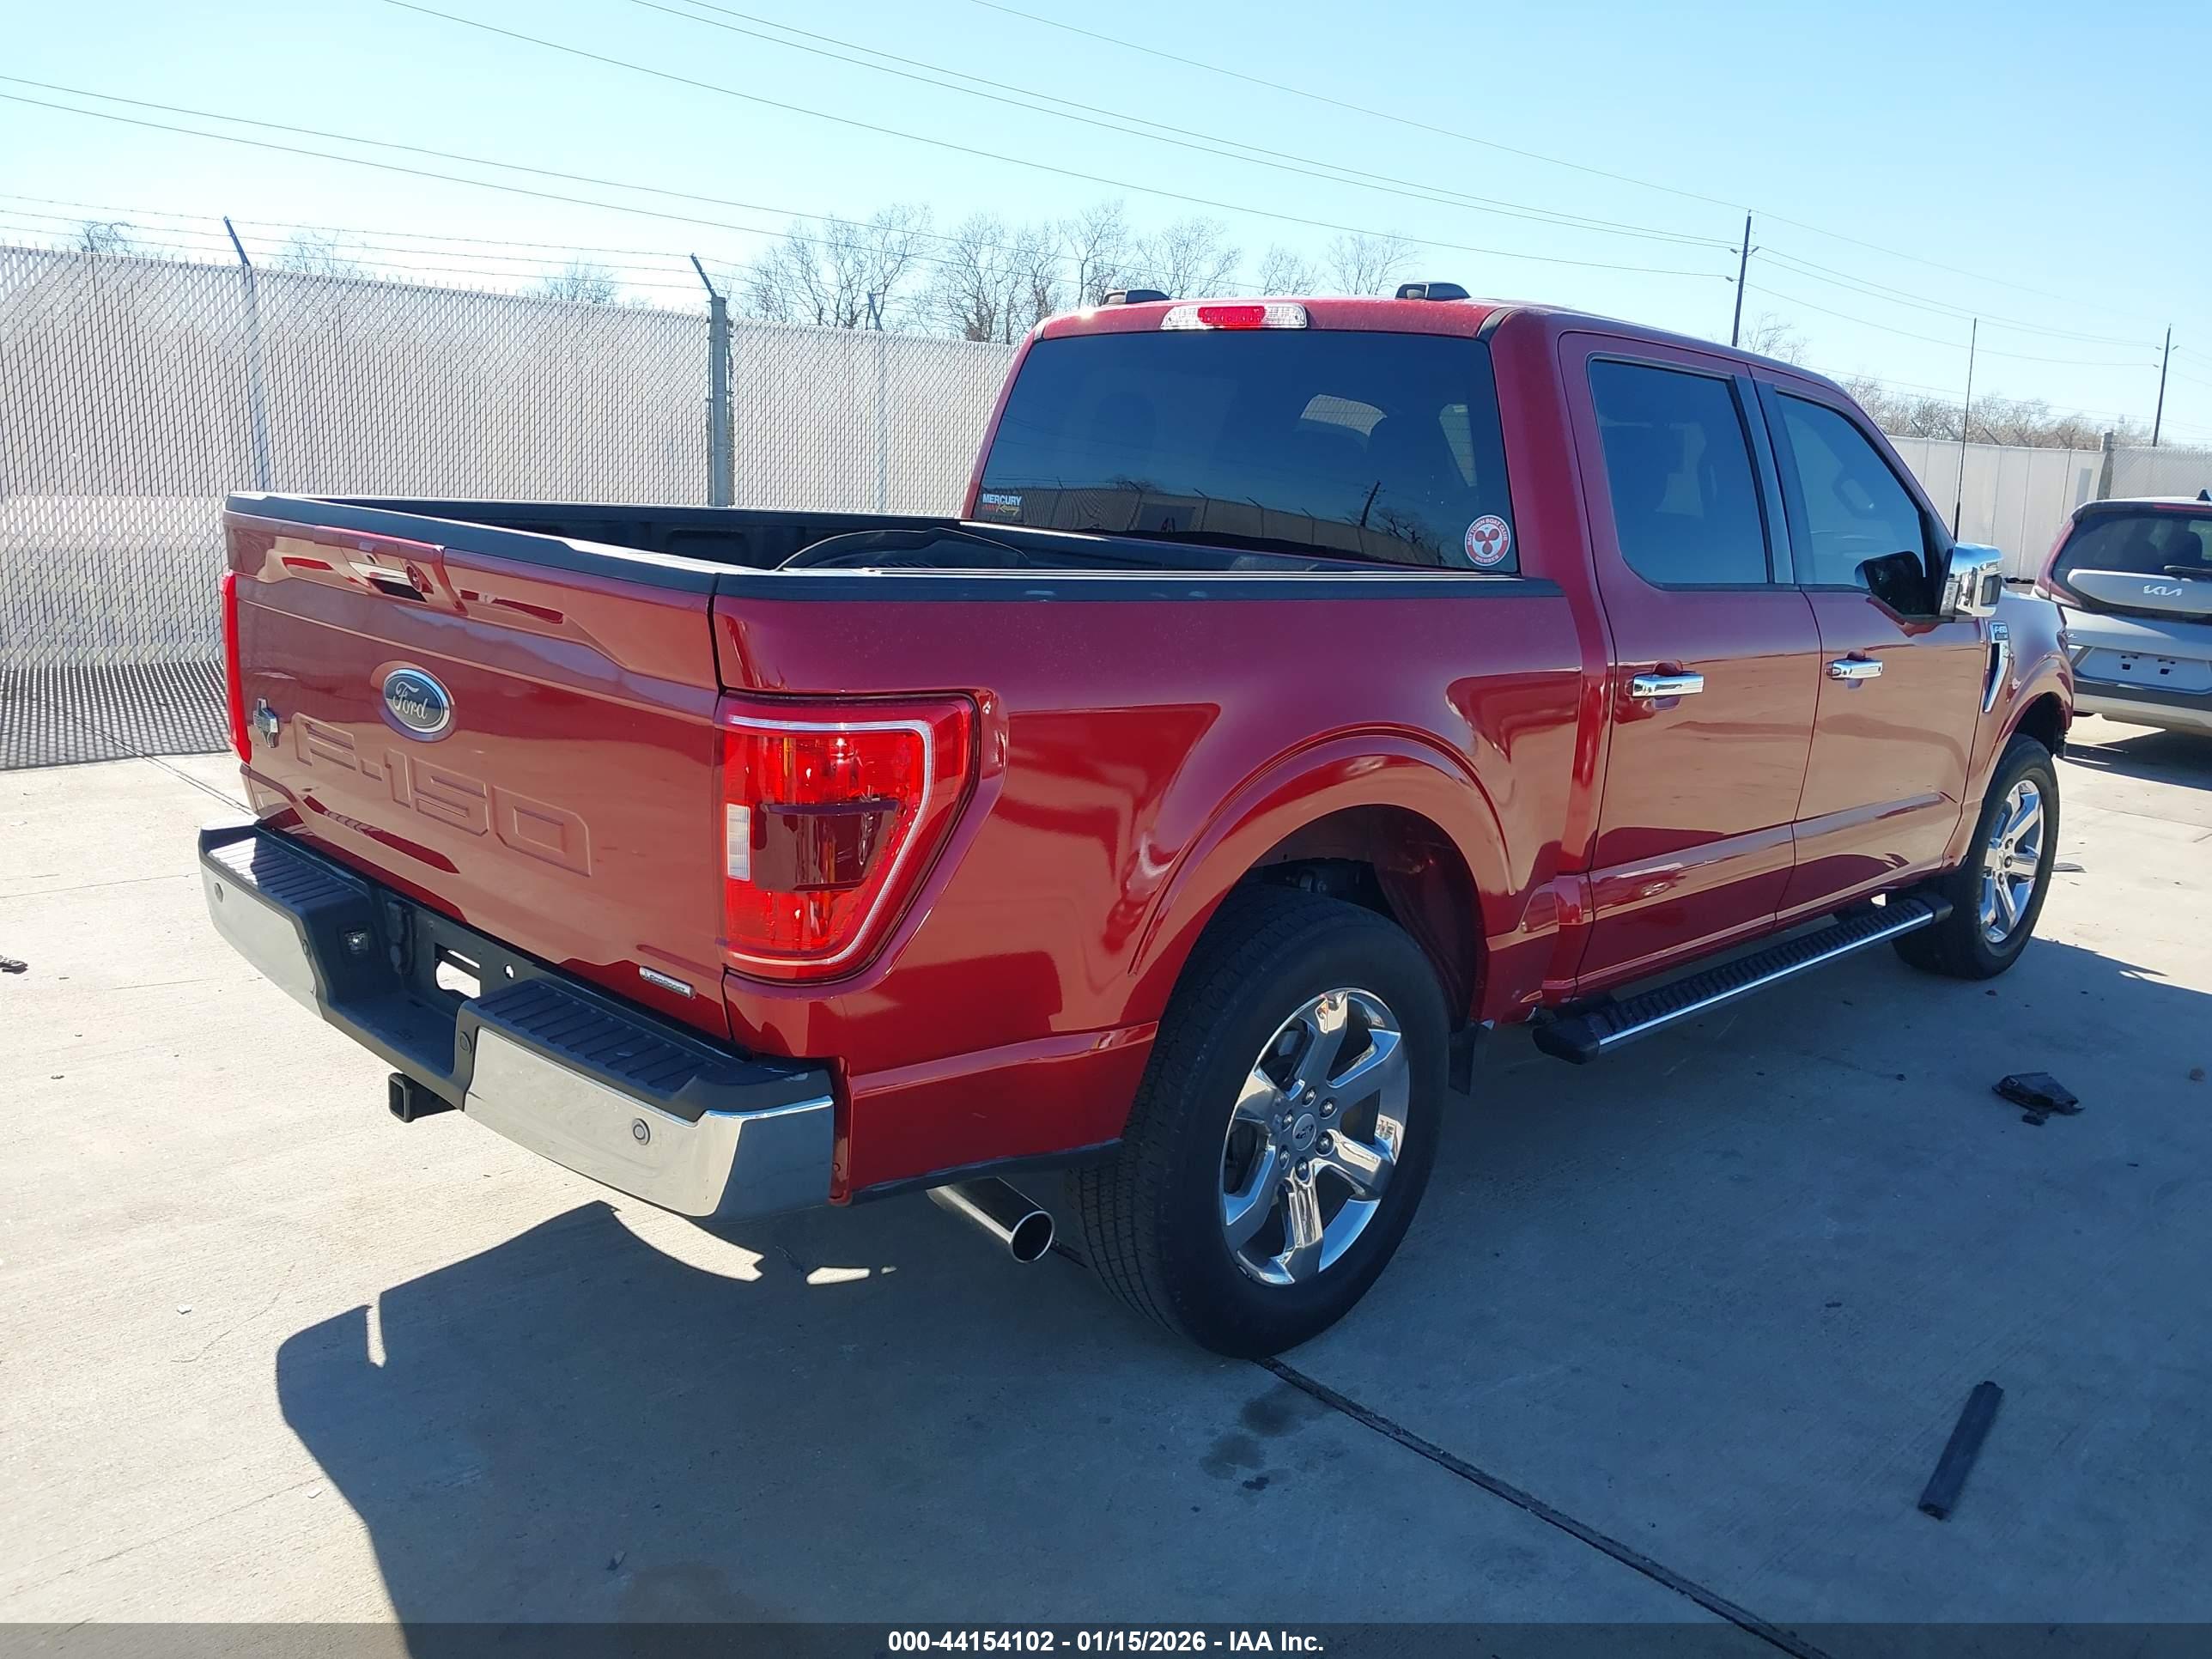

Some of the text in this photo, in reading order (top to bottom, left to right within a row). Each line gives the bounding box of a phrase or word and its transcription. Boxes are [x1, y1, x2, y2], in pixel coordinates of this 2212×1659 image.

[982, 493, 1022, 506] MERCURY
[1467, 518, 1509, 546] BAYTOWN BOAT CLUB
[392, 681, 428, 721] Ford
[291, 712, 592, 877] F-150
